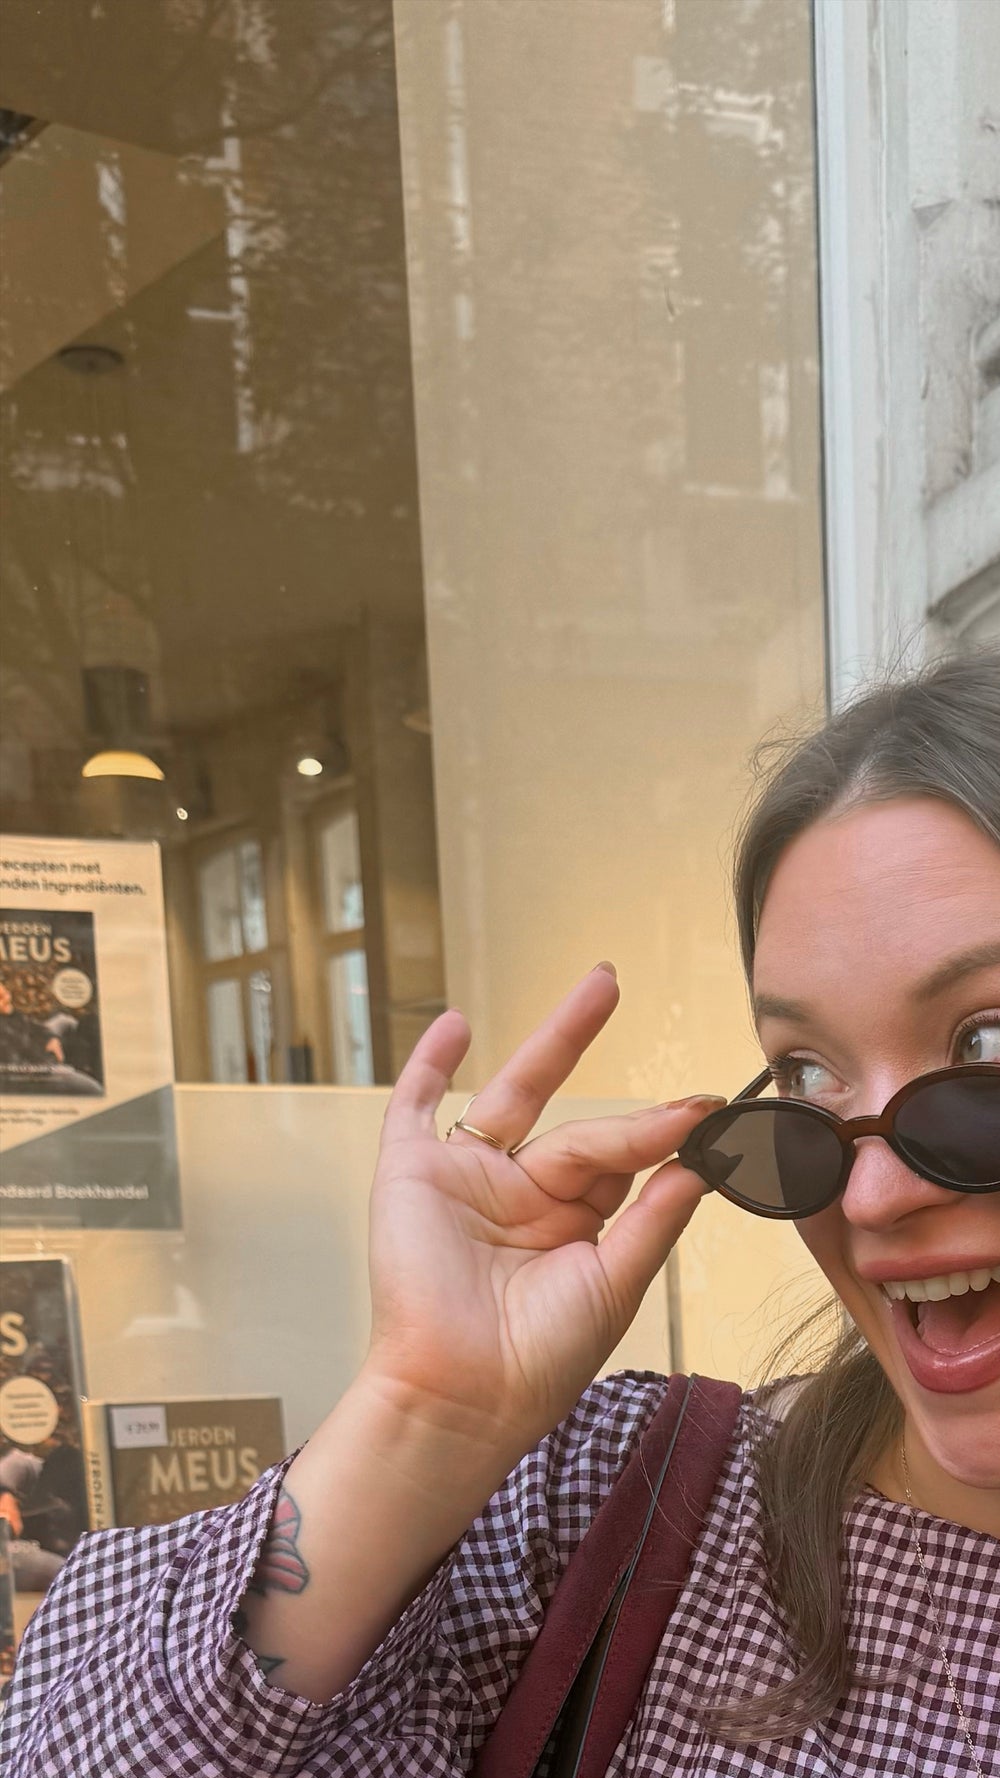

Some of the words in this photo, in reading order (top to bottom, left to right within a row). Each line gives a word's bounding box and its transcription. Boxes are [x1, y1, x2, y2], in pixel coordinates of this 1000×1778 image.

[0, 861, 67, 875] ecepten
[70, 861, 100, 874] met
[0, 877, 40, 892] nden
[0, 936, 72, 963] EUS
[54, 1182, 150, 1200] Boekhandel
[168, 1425, 237, 1448] JEROEN
[150, 1446, 261, 1496] MEUS
